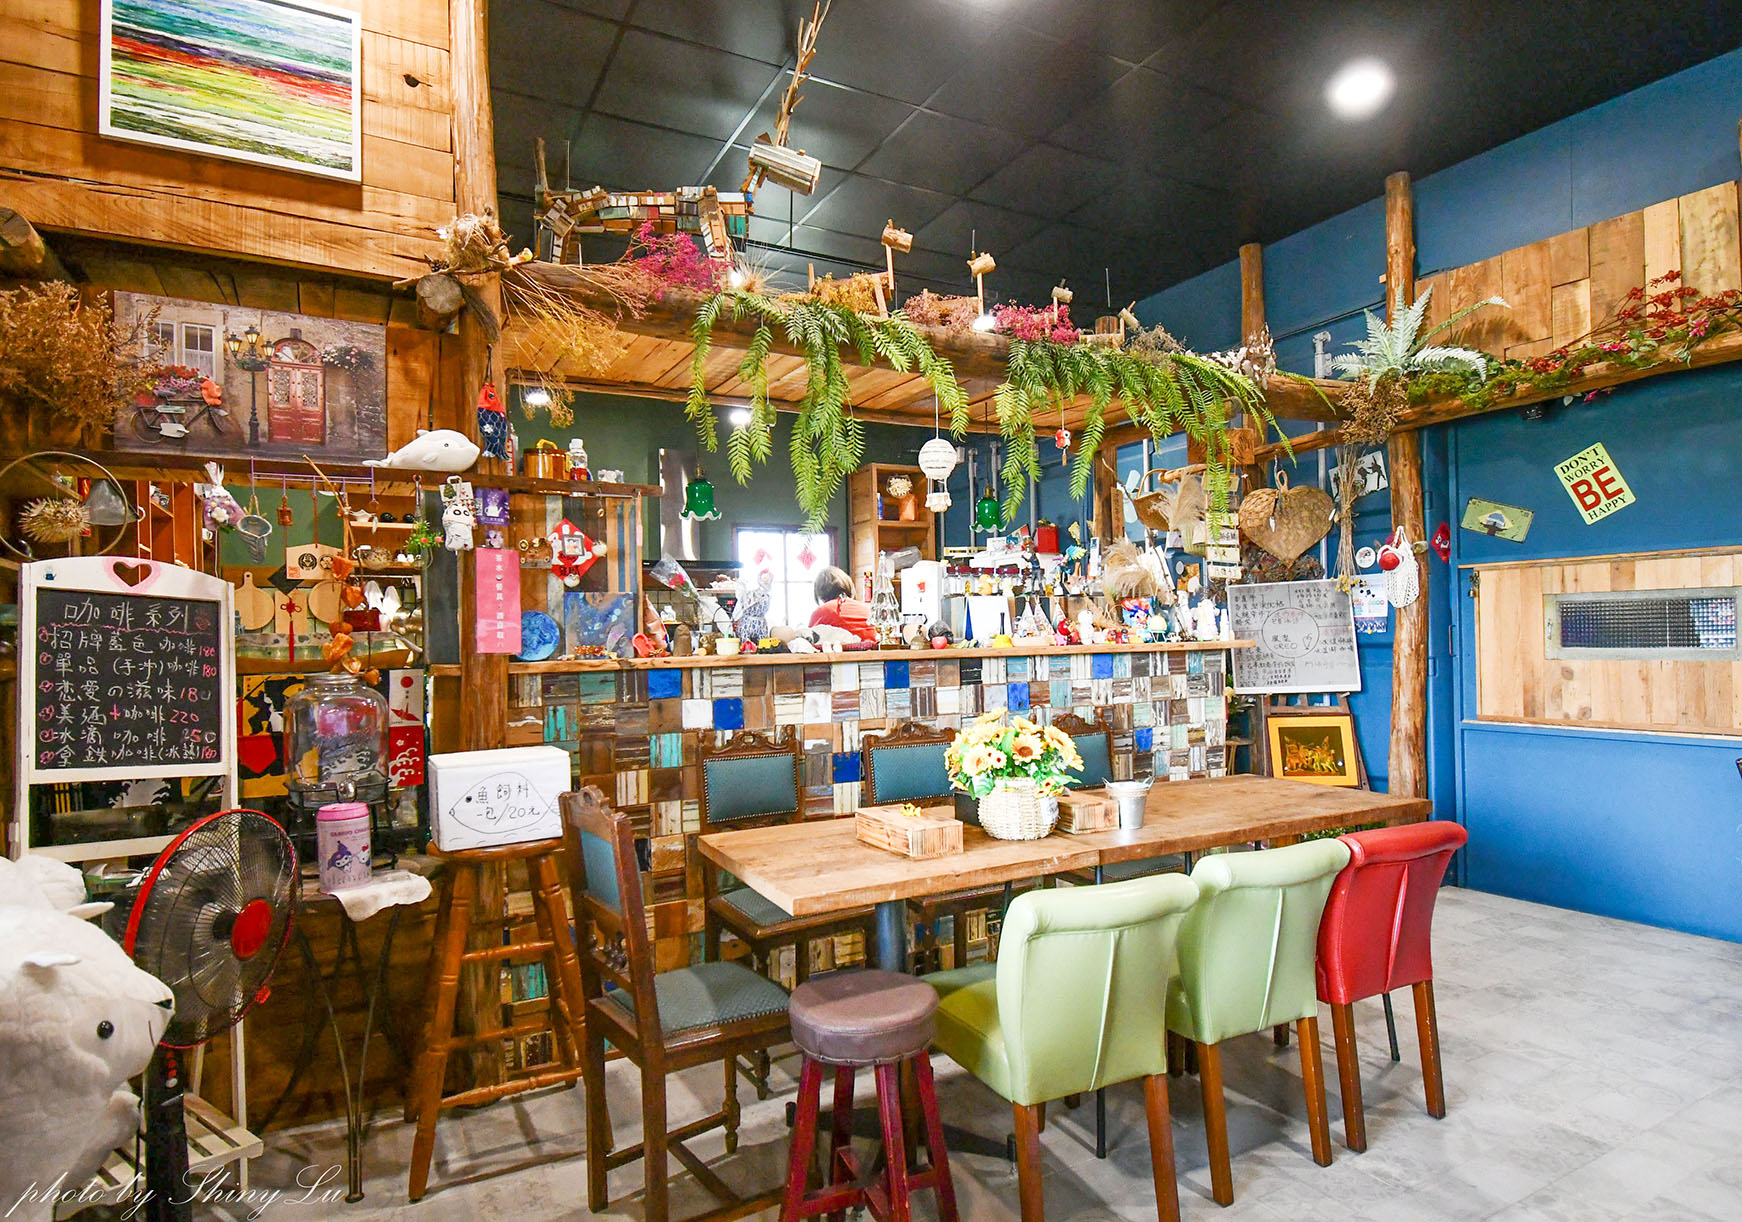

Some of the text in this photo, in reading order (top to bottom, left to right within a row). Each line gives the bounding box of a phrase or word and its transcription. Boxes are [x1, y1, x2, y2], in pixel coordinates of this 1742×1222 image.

[1559, 446, 1601, 475] DON'T
[1564, 455, 1606, 483] WORRY
[1570, 465, 1625, 512] BE
[1588, 494, 1627, 520] HAPPY
[64, 598, 188, 632] 咖啡系列
[202, 664, 217, 677] 180
[169, 709, 200, 724] 220
[475, 783, 529, 804] 魚飼料
